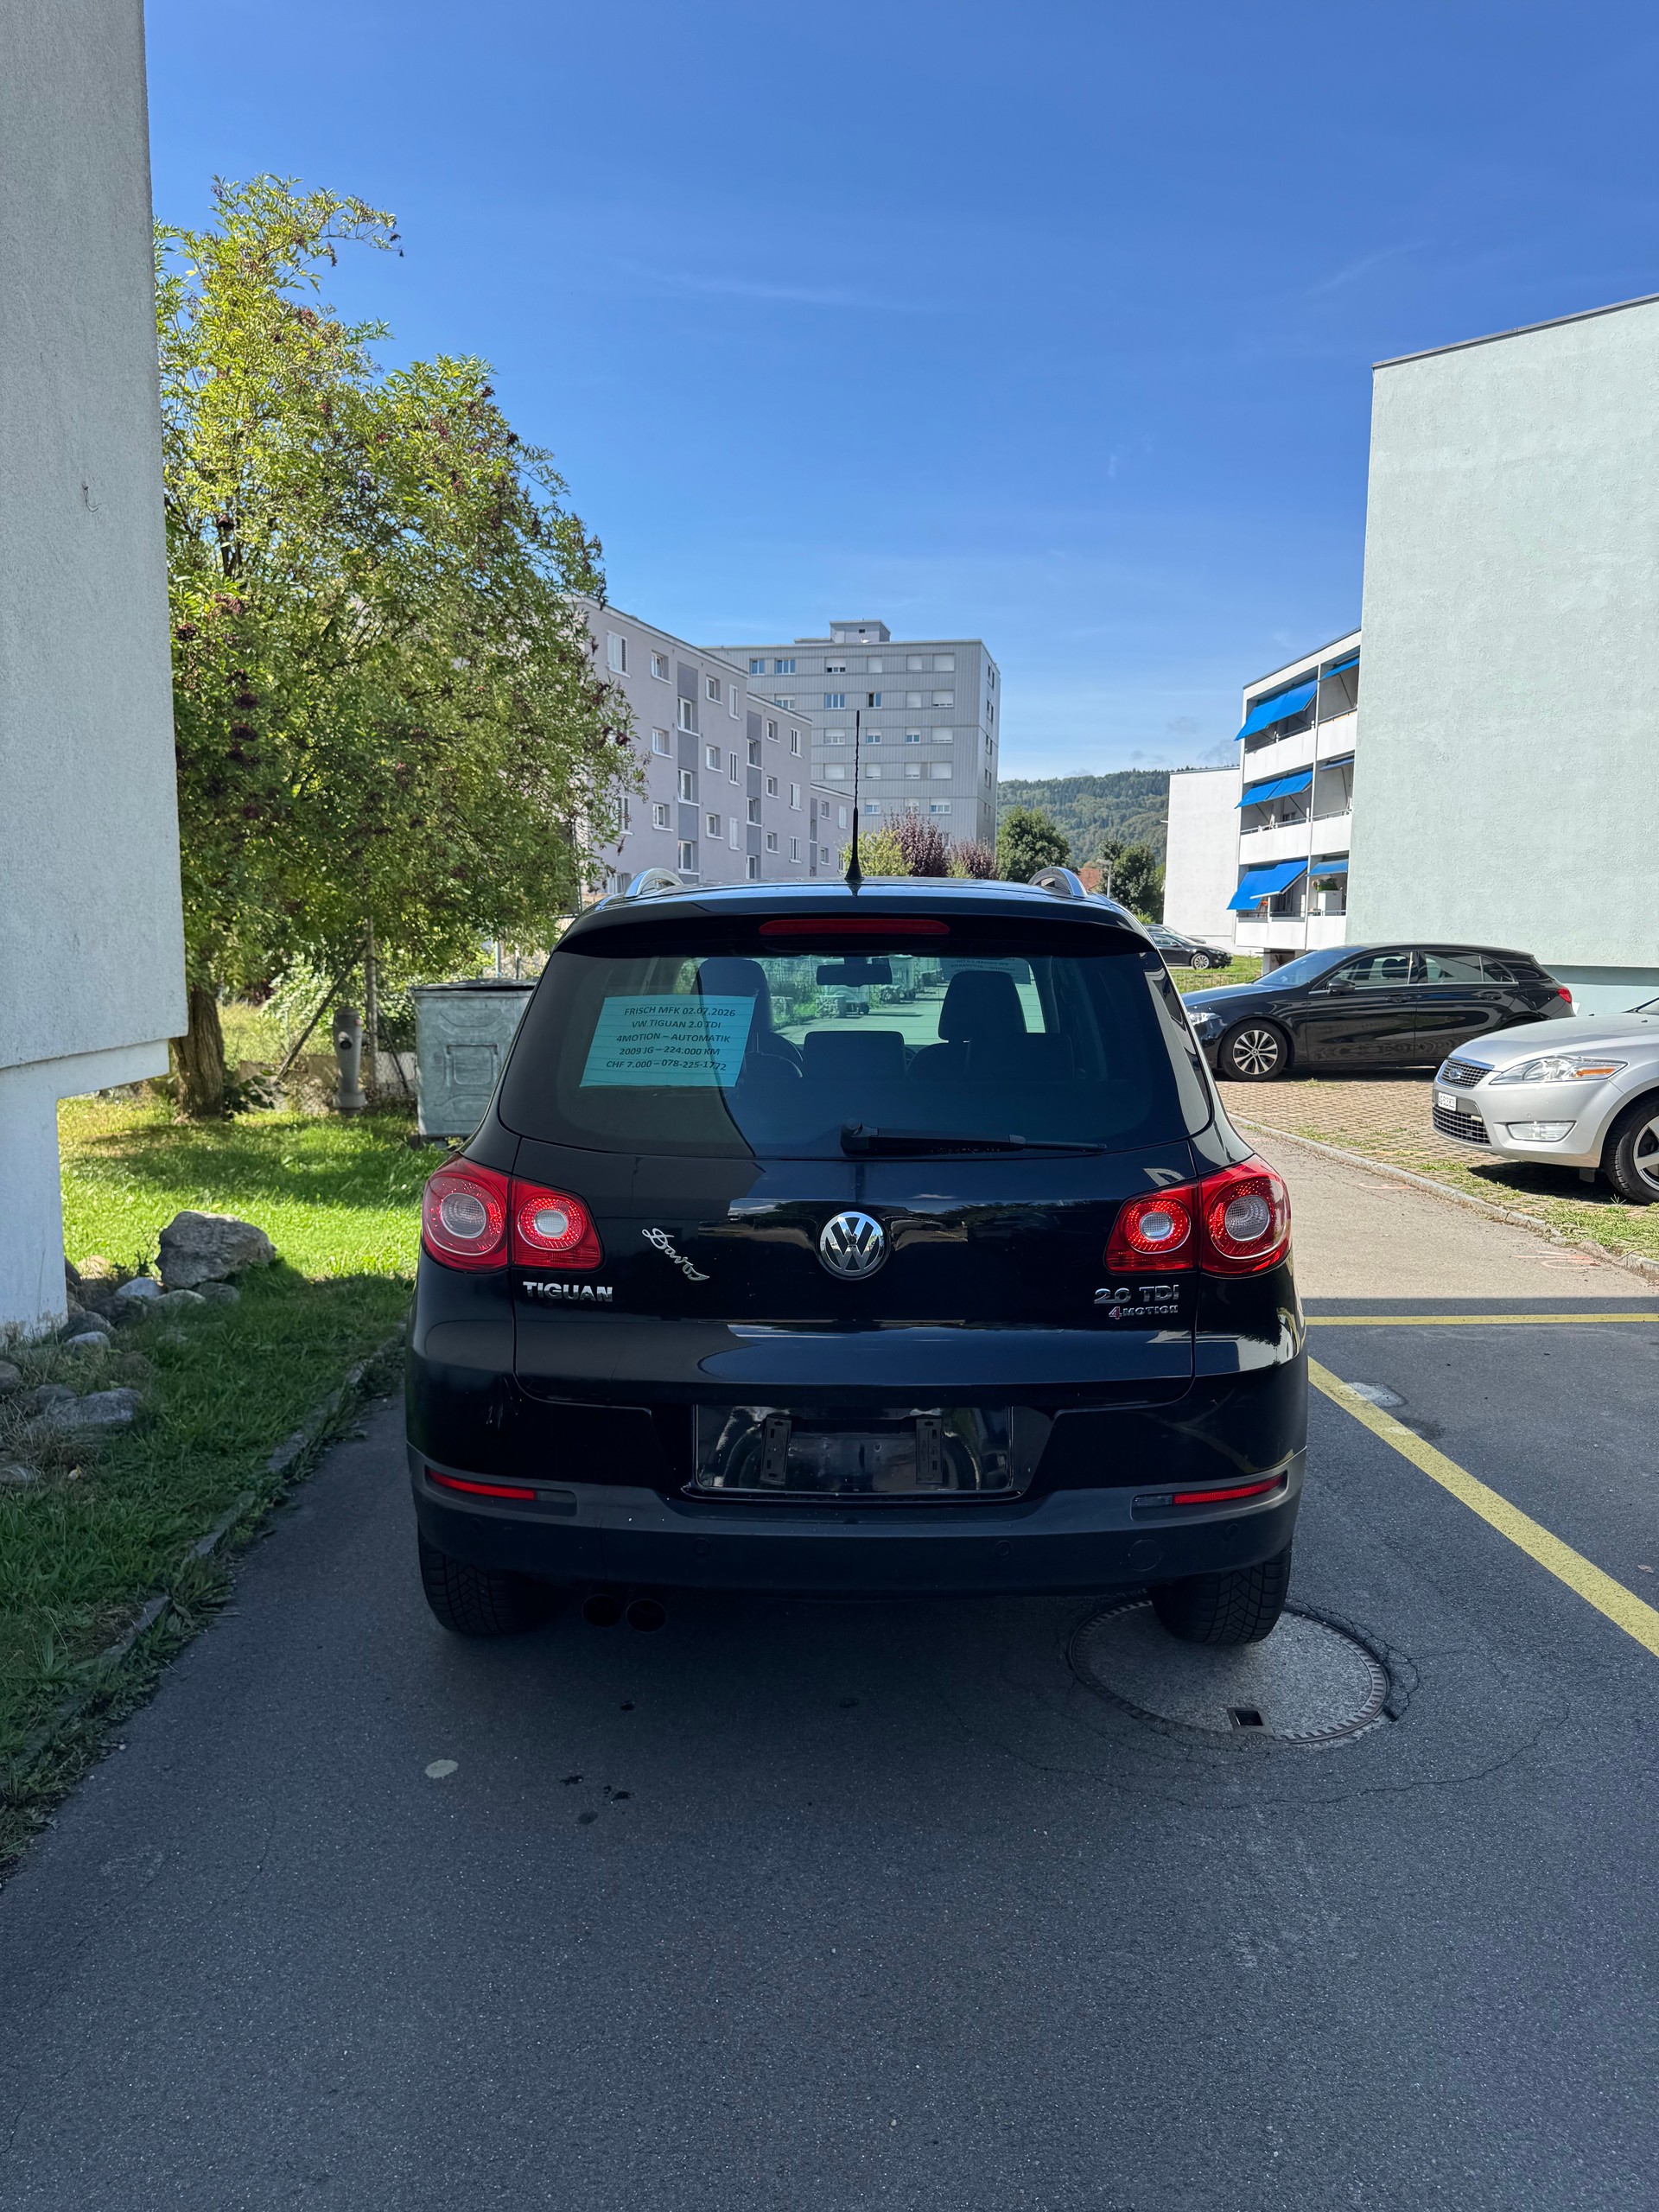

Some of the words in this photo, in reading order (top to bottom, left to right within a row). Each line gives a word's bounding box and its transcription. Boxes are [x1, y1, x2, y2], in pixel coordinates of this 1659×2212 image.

[624, 1007, 656, 1015] FRISCH
[683, 1007, 735, 1016] 02.07.2026
[616, 1033, 661, 1042] 4MOTION
[671, 1033, 731, 1043] AUTOMATIK
[664, 1046, 702, 1055] 224.000
[661, 1059, 727, 1071] 078-225-1772
[523, 1281, 613, 1302] TIGUAN
[1139, 1284, 1179, 1302] TDI
[1109, 1305, 1179, 1319] 4MOTION
